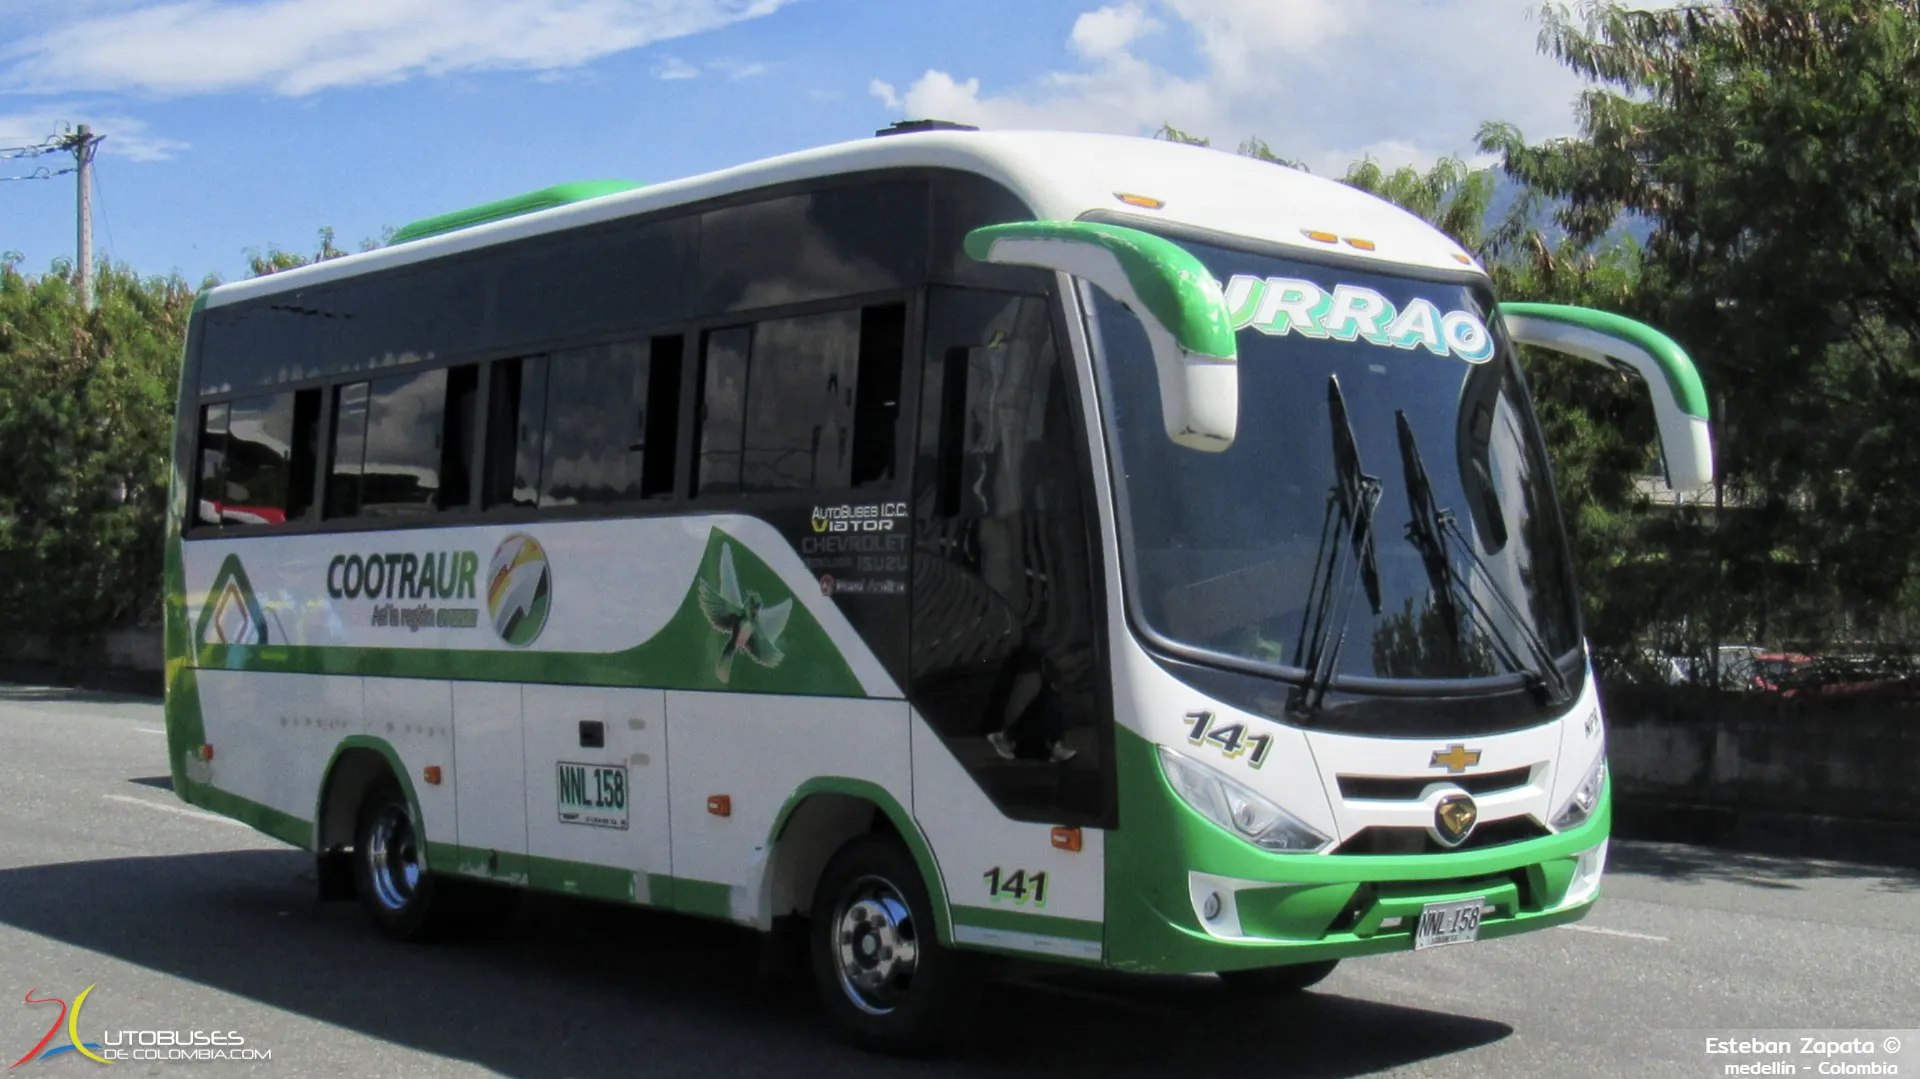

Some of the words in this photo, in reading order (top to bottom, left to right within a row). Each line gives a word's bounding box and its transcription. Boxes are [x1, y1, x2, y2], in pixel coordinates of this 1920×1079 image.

[802, 534, 908, 554] CHEVROLET
[327, 551, 479, 599] COOTRAUR
[1183, 710, 1275, 770] 141
[560, 765, 593, 807] NNL
[594, 767, 625, 810] 158
[983, 865, 1048, 908] 141
[1419, 910, 1446, 938] NNL
[1450, 906, 1480, 933] 158
